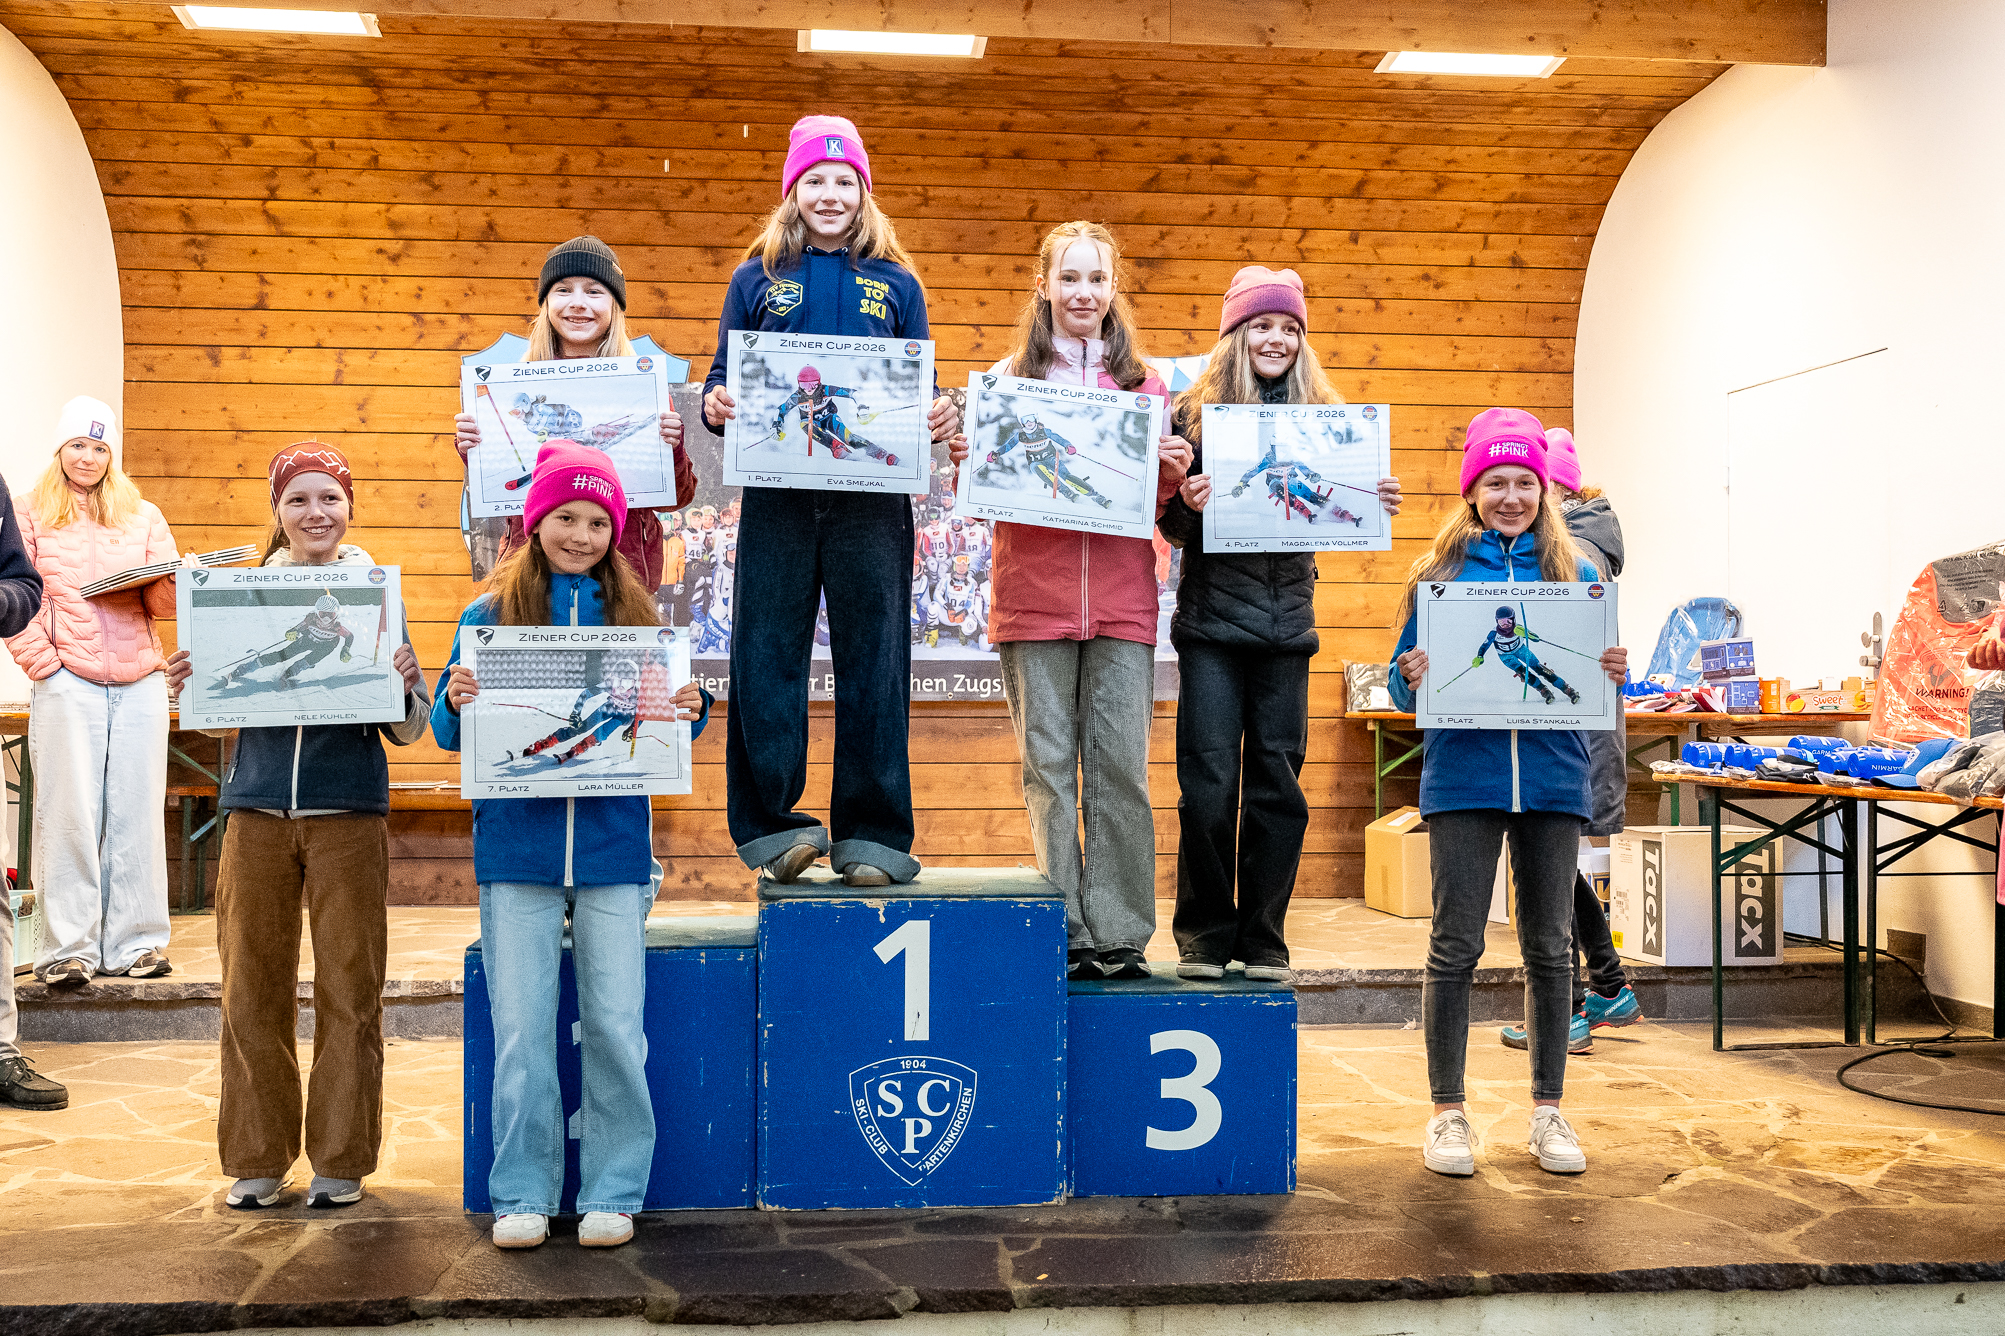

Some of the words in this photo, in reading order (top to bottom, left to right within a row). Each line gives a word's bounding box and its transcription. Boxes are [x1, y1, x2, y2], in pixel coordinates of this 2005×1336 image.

[831, 140, 841, 151] K
[855, 276, 889, 293] BORN
[863, 286, 884, 300] TO
[859, 300, 887, 320] SKI
[779, 339, 823, 350] ZIENER
[826, 341, 852, 351] CUP
[854, 343, 886, 353] 2026
[512, 367, 556, 377] ZIENER
[558, 365, 584, 375] CUP
[586, 363, 619, 373] 2026
[1016, 383, 1058, 395] ZIENER
[1060, 388, 1085, 398] CUP
[1087, 391, 1118, 403] 2026
[1316, 410, 1346, 418] 2026
[94, 425, 102, 435] K
[1502, 447, 1529, 458] PINK
[755, 475, 783, 483] PLATZ
[827, 478, 845, 486] EVA
[846, 478, 886, 488] SMEJKAL
[588, 480, 615, 502] PINK
[494, 504, 503, 512] 2.
[504, 503, 525, 511] PLAT
[977, 507, 986, 515] 3.
[987, 508, 1014, 518] PLATZ
[1042, 515, 1089, 527] KATHARINA
[1091, 521, 1123, 532] SCHMID
[1234, 540, 1259, 548] PLATZ
[233, 574, 280, 583] ZIENER
[283, 573, 311, 582] CUP
[314, 573, 349, 582] 2026
[1466, 587, 1508, 596] ZIENER
[1510, 587, 1536, 596] CUP
[1538, 588, 1570, 596] 2026
[518, 633, 567, 642] ZIENER
[570, 633, 599, 642] CUP
[601, 633, 637, 642] 2026
[1915, 688, 1970, 699] WARNING!
[1812, 695, 1844, 706] Sweet
[294, 713, 318, 721] NELE
[319, 713, 358, 721] KUHLEN
[605, 782, 644, 790] MÜLLER
[1644, 847, 1660, 948] Tacx
[1740, 848, 1770, 950] Tacx
[873, 919, 931, 1042] 1
[1604, 995, 1630, 1016] DYNAFIT
[900, 1059, 927, 1069] 1904
[1145, 1029, 1223, 1152] 3
[900, 1117, 932, 1153] P
